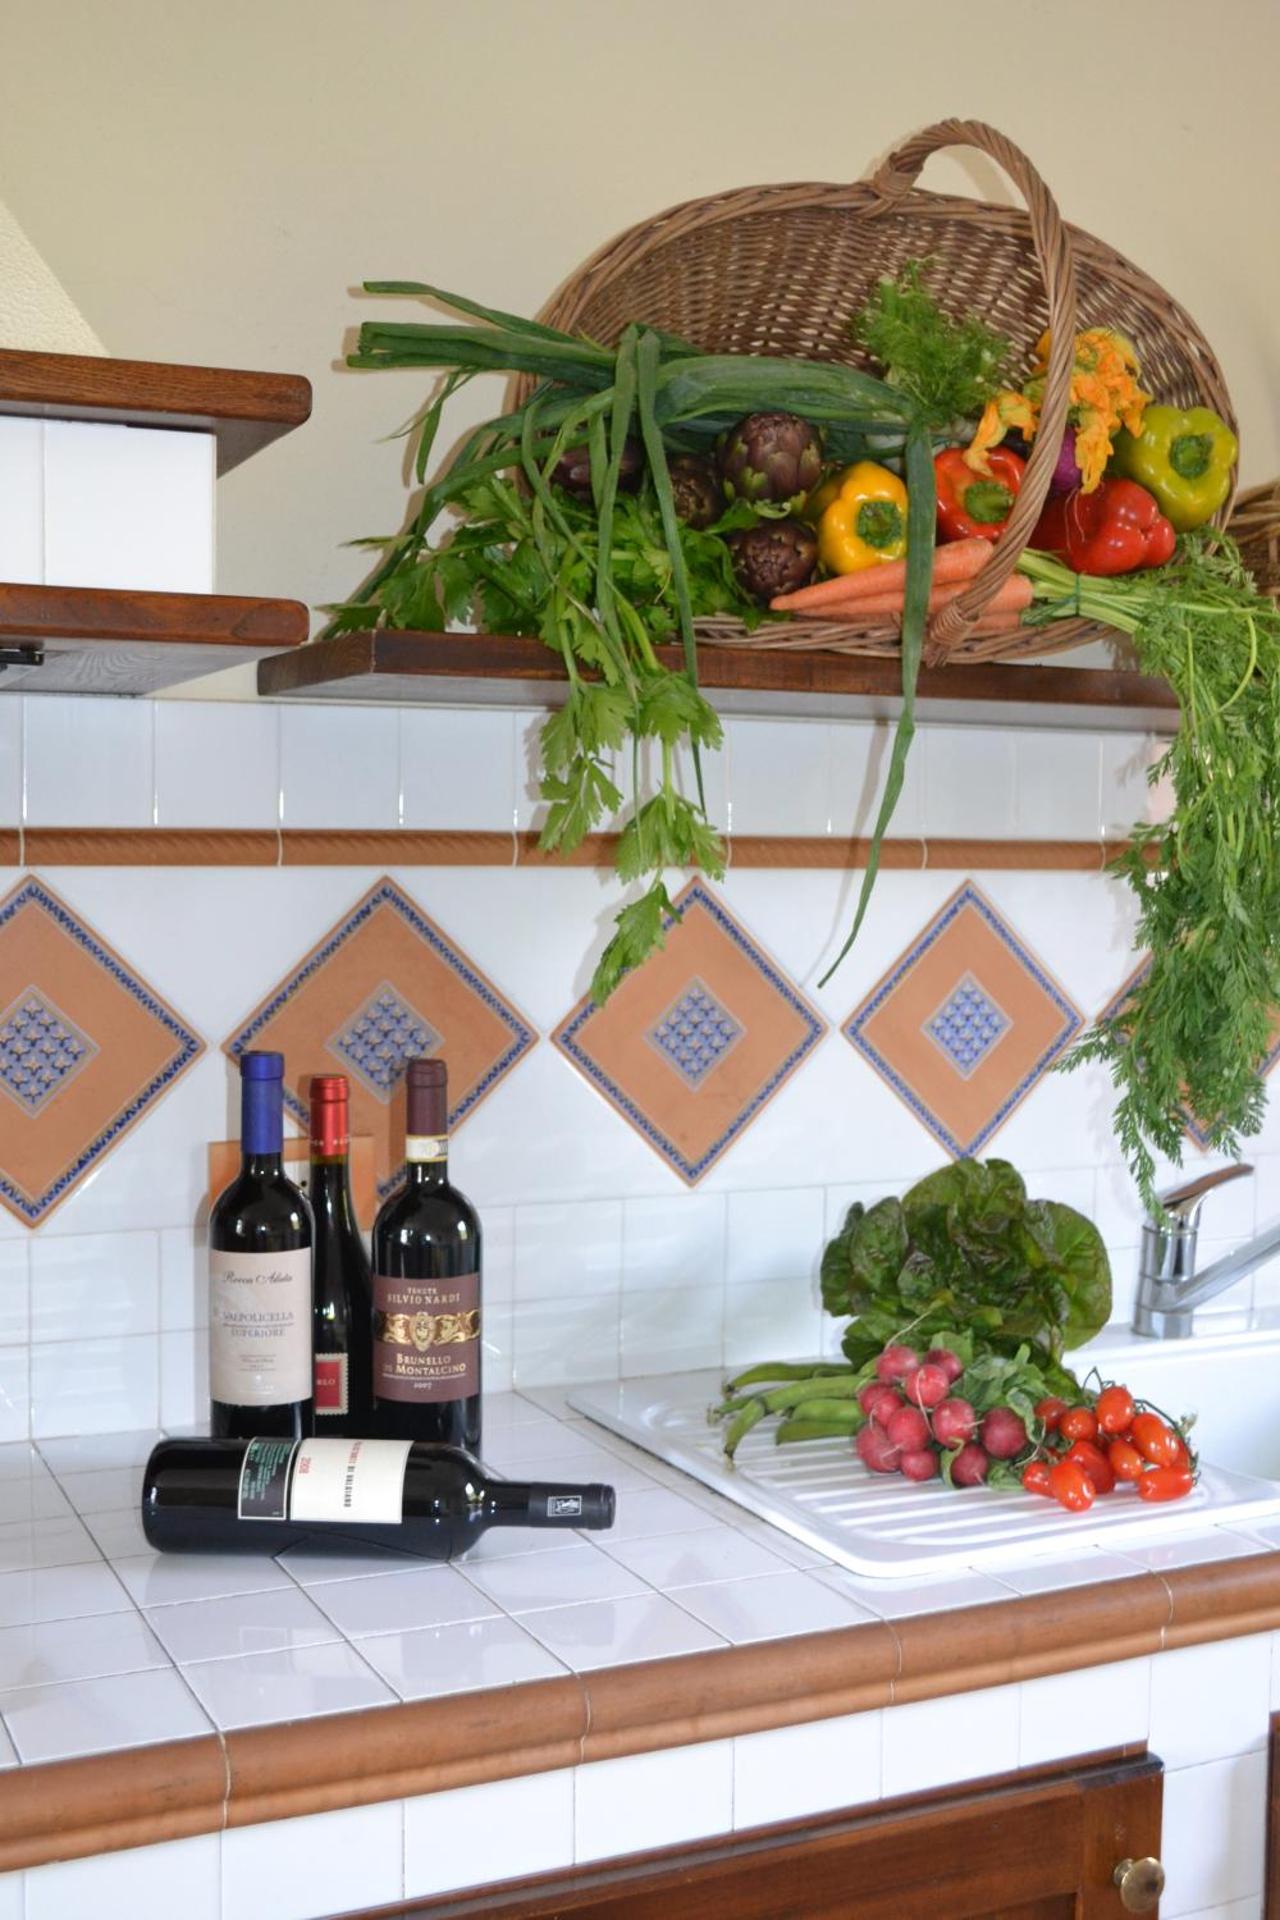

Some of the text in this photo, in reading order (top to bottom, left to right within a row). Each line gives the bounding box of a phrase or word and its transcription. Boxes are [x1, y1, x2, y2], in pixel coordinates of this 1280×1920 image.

[387, 1293, 460, 1305] SILVIO NARDI
[396, 1353, 452, 1365] BRUNELLO
[395, 1363, 466, 1375] MONTALCINO
